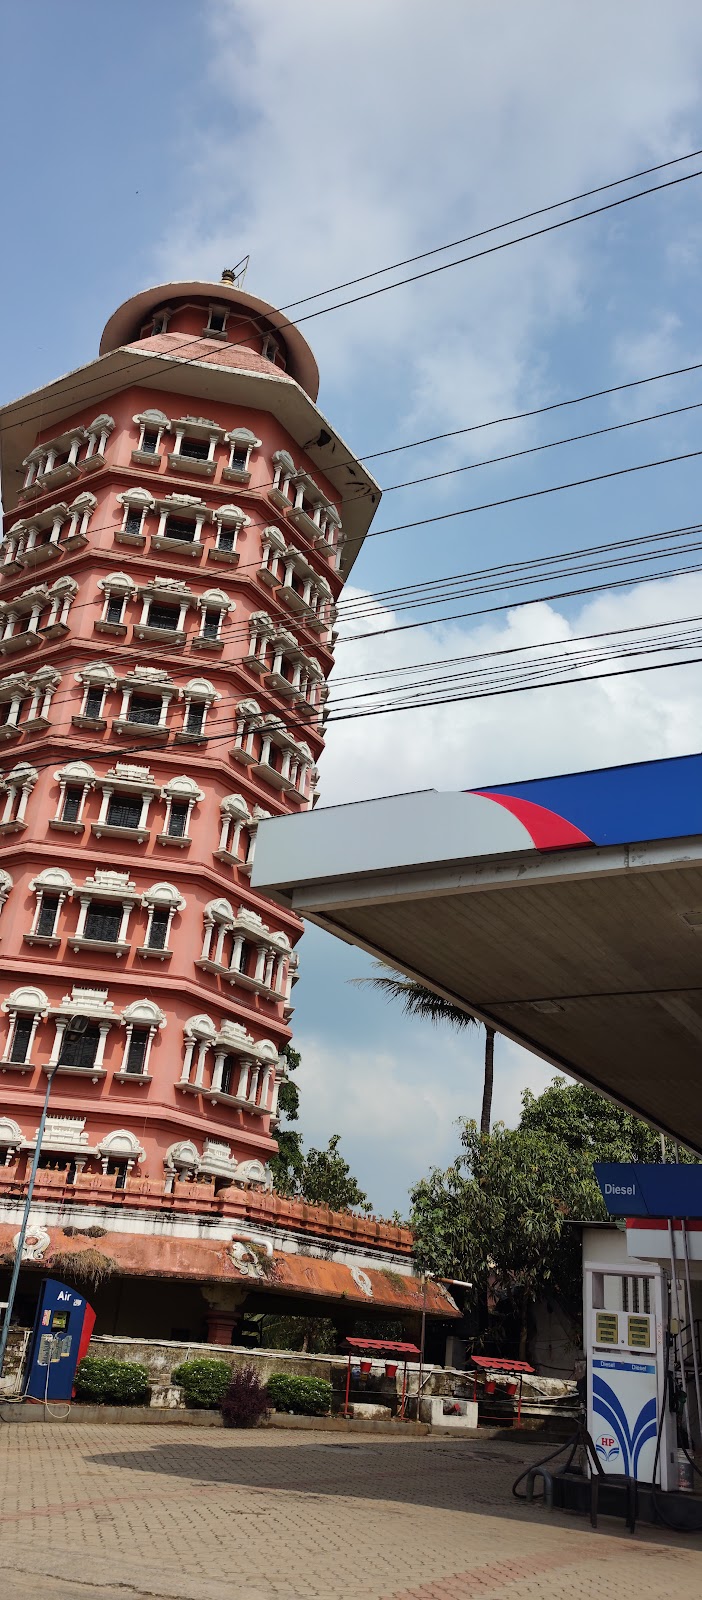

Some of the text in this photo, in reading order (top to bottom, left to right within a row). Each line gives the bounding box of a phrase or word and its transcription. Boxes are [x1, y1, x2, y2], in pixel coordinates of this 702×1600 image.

[604, 1184, 636, 1195] Diesel
[57, 1291, 72, 1301] Air
[601, 1438, 614, 1446] HP
